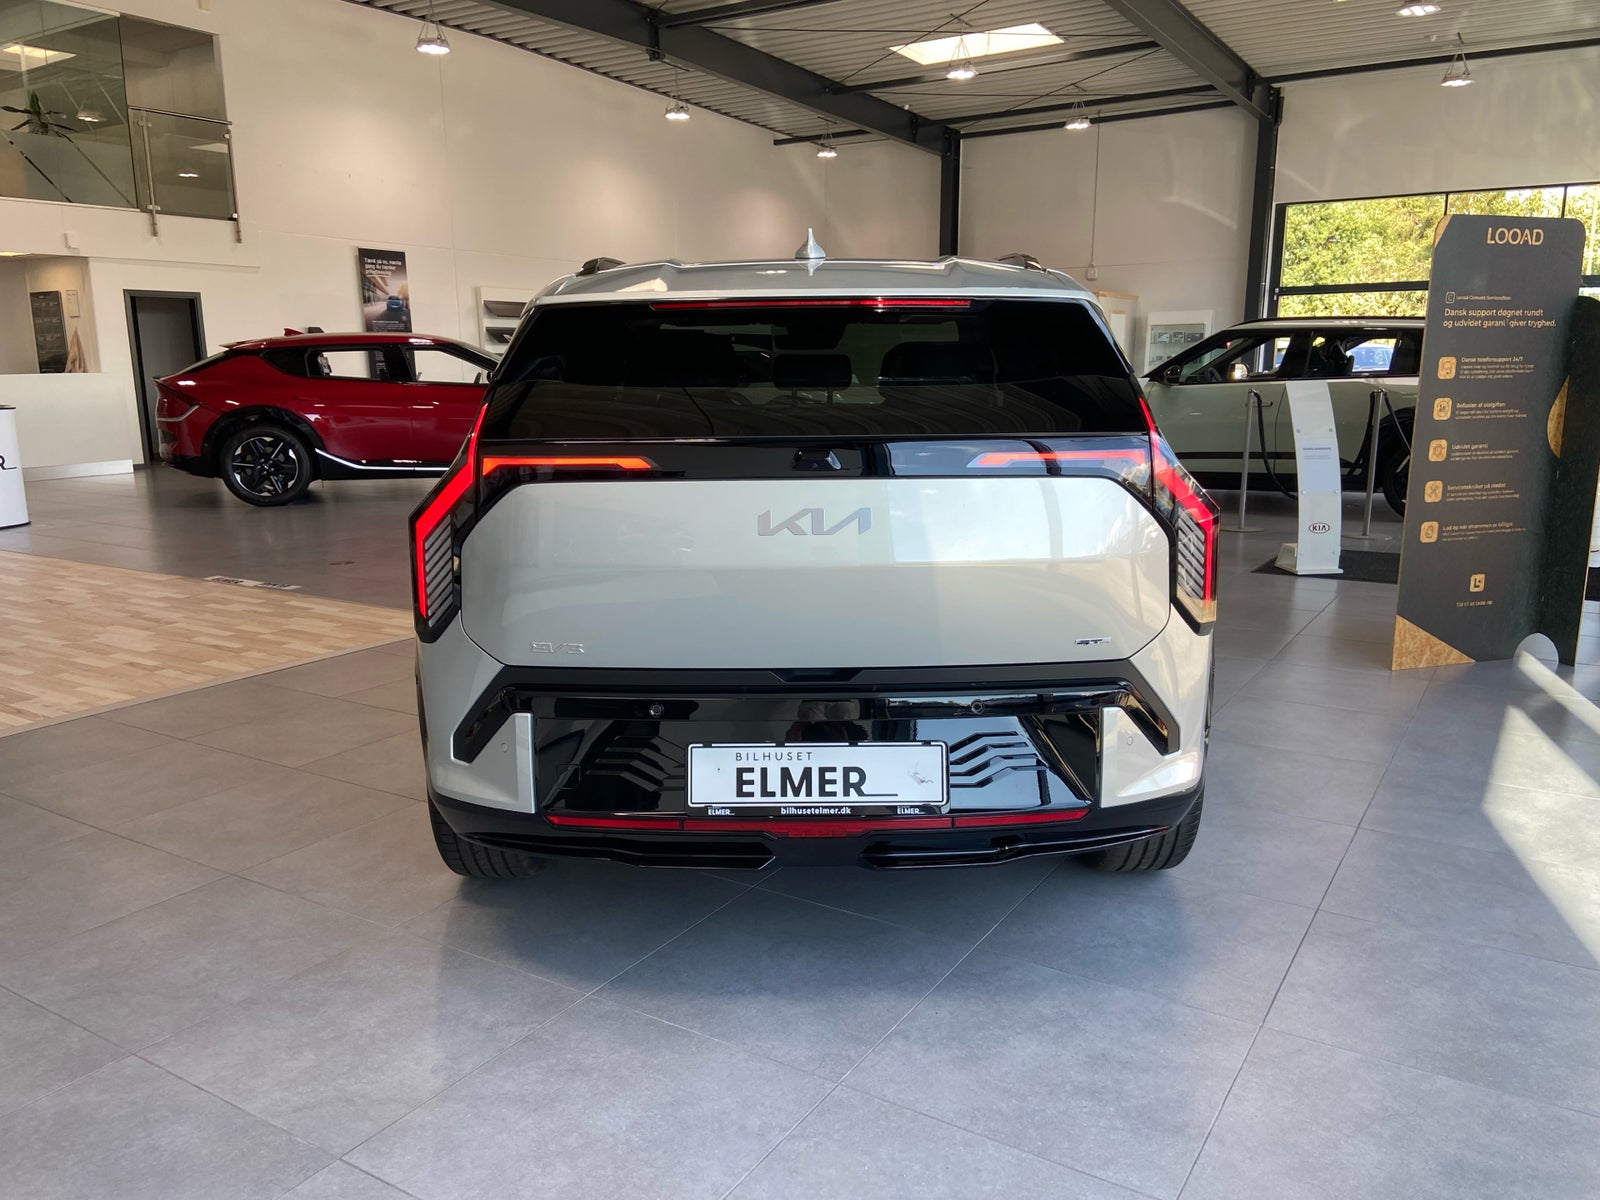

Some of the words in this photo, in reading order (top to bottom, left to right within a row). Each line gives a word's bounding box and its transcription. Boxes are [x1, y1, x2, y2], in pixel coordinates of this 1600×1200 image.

[1486, 227, 1544, 245] LOOAD
[1445, 308, 1467, 316] Dansk
[1469, 309, 1496, 318] support
[1497, 308, 1523, 318] døgnet
[1443, 320, 1453, 328] og
[1454, 319, 1482, 327] udvidet
[1509, 319, 1527, 328] giver
[1528, 320, 1556, 329] tryghed.
[530, 642, 584, 654] EV3
[736, 752, 813, 761] BILHUSET
[736, 766, 878, 798] ELMER
[780, 807, 851, 815] bilhusetelmer.dk
